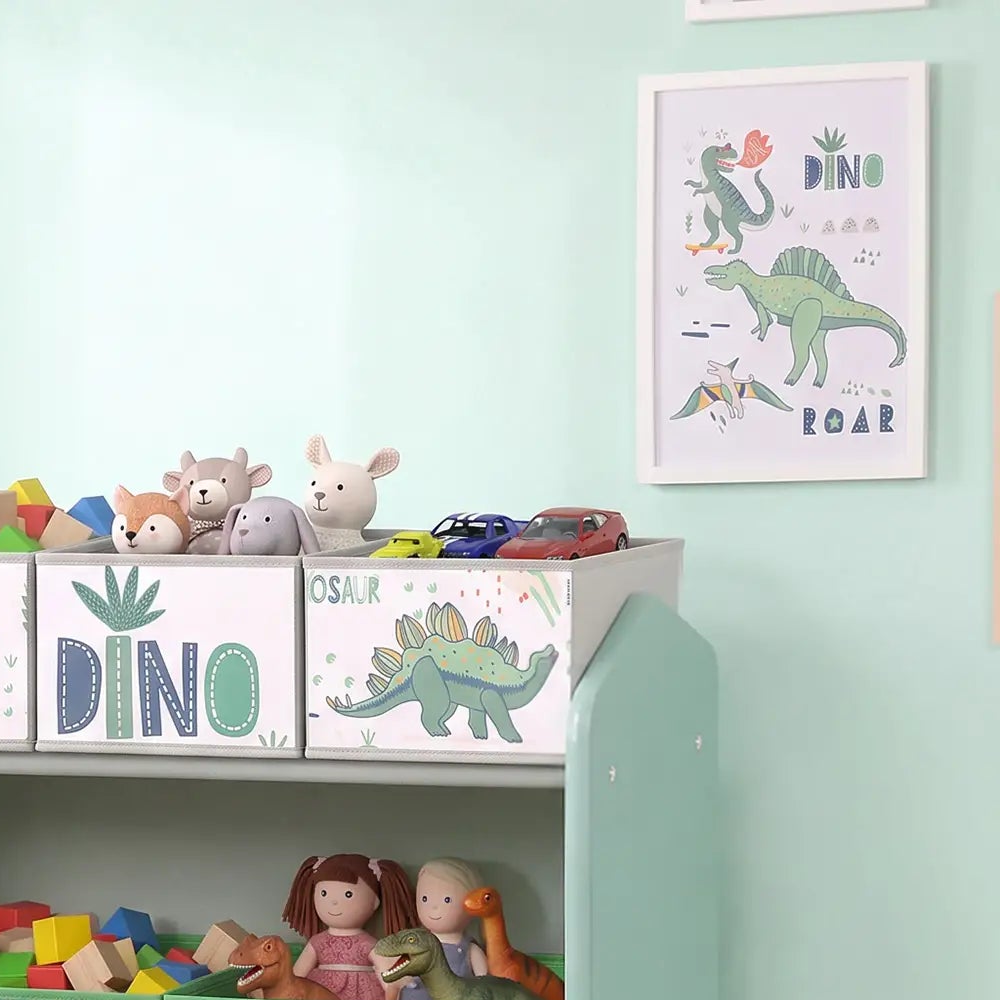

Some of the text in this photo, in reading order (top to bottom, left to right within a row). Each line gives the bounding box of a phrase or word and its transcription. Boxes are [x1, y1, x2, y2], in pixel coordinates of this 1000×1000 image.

[804, 153, 884, 191] DINO
[803, 404, 895, 435] ROAR
[309, 574, 381, 604] OSAUR
[57, 635, 260, 739] DINO
